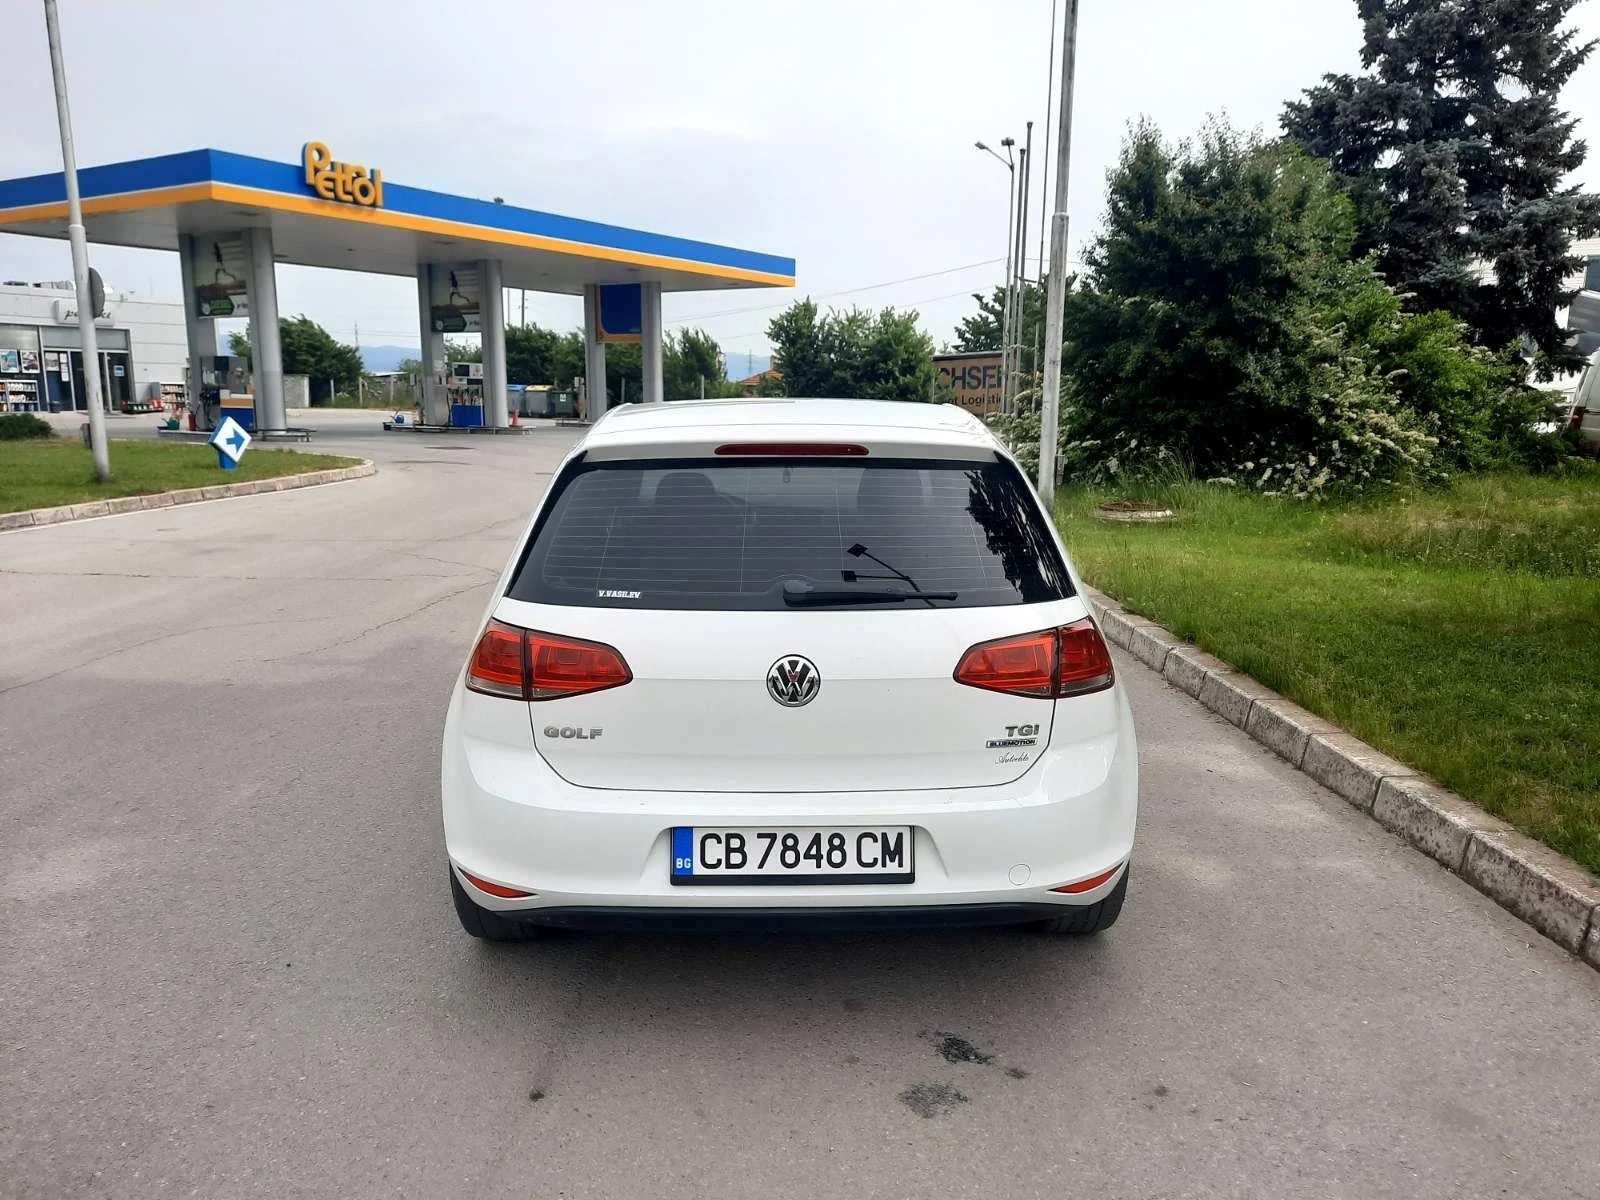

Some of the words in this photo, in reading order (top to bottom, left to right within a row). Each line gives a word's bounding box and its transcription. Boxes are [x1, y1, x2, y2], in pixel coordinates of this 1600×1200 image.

[302, 141, 383, 208] Petrol
[599, 589, 641, 599] V.VASILEV
[543, 726, 604, 739] GOLF
[1005, 724, 1040, 737] TGI
[988, 739, 1036, 747] BLUEMOTION
[676, 858, 692, 869] BG
[700, 833, 748, 869] CB
[756, 832, 847, 869] 7848
[856, 832, 904, 868] CM
